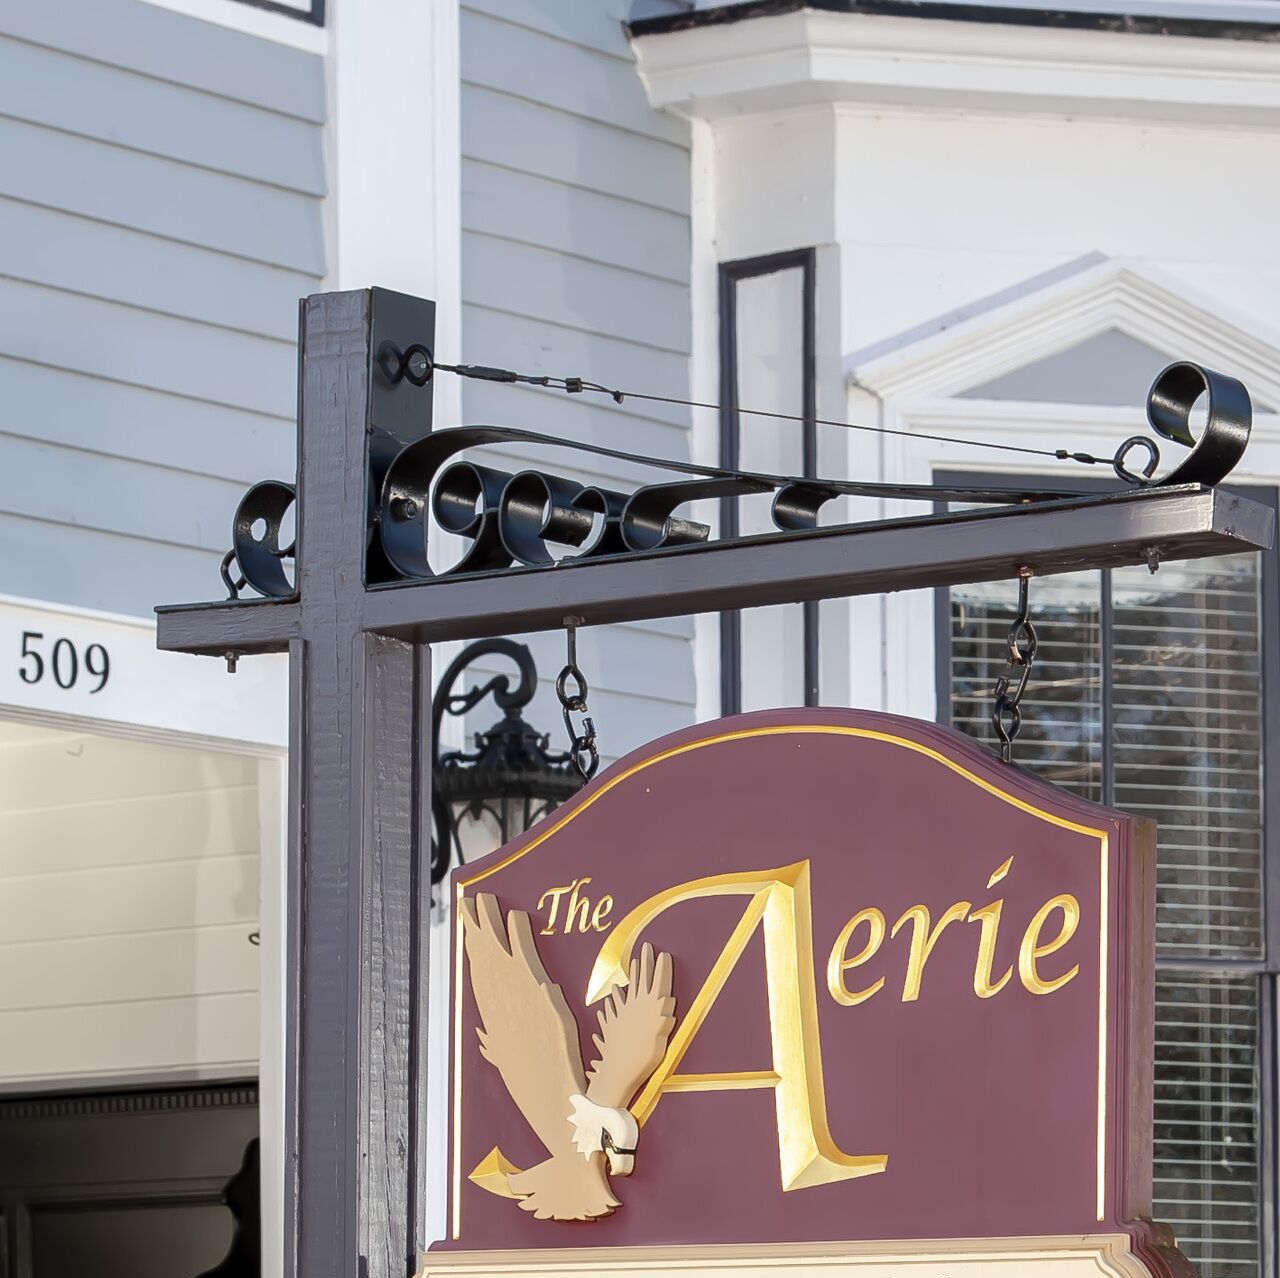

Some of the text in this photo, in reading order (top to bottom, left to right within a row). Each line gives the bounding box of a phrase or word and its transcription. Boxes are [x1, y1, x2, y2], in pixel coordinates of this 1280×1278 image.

[18, 630, 110, 695] 509
[467, 855, 1080, 1194] The Aerie
